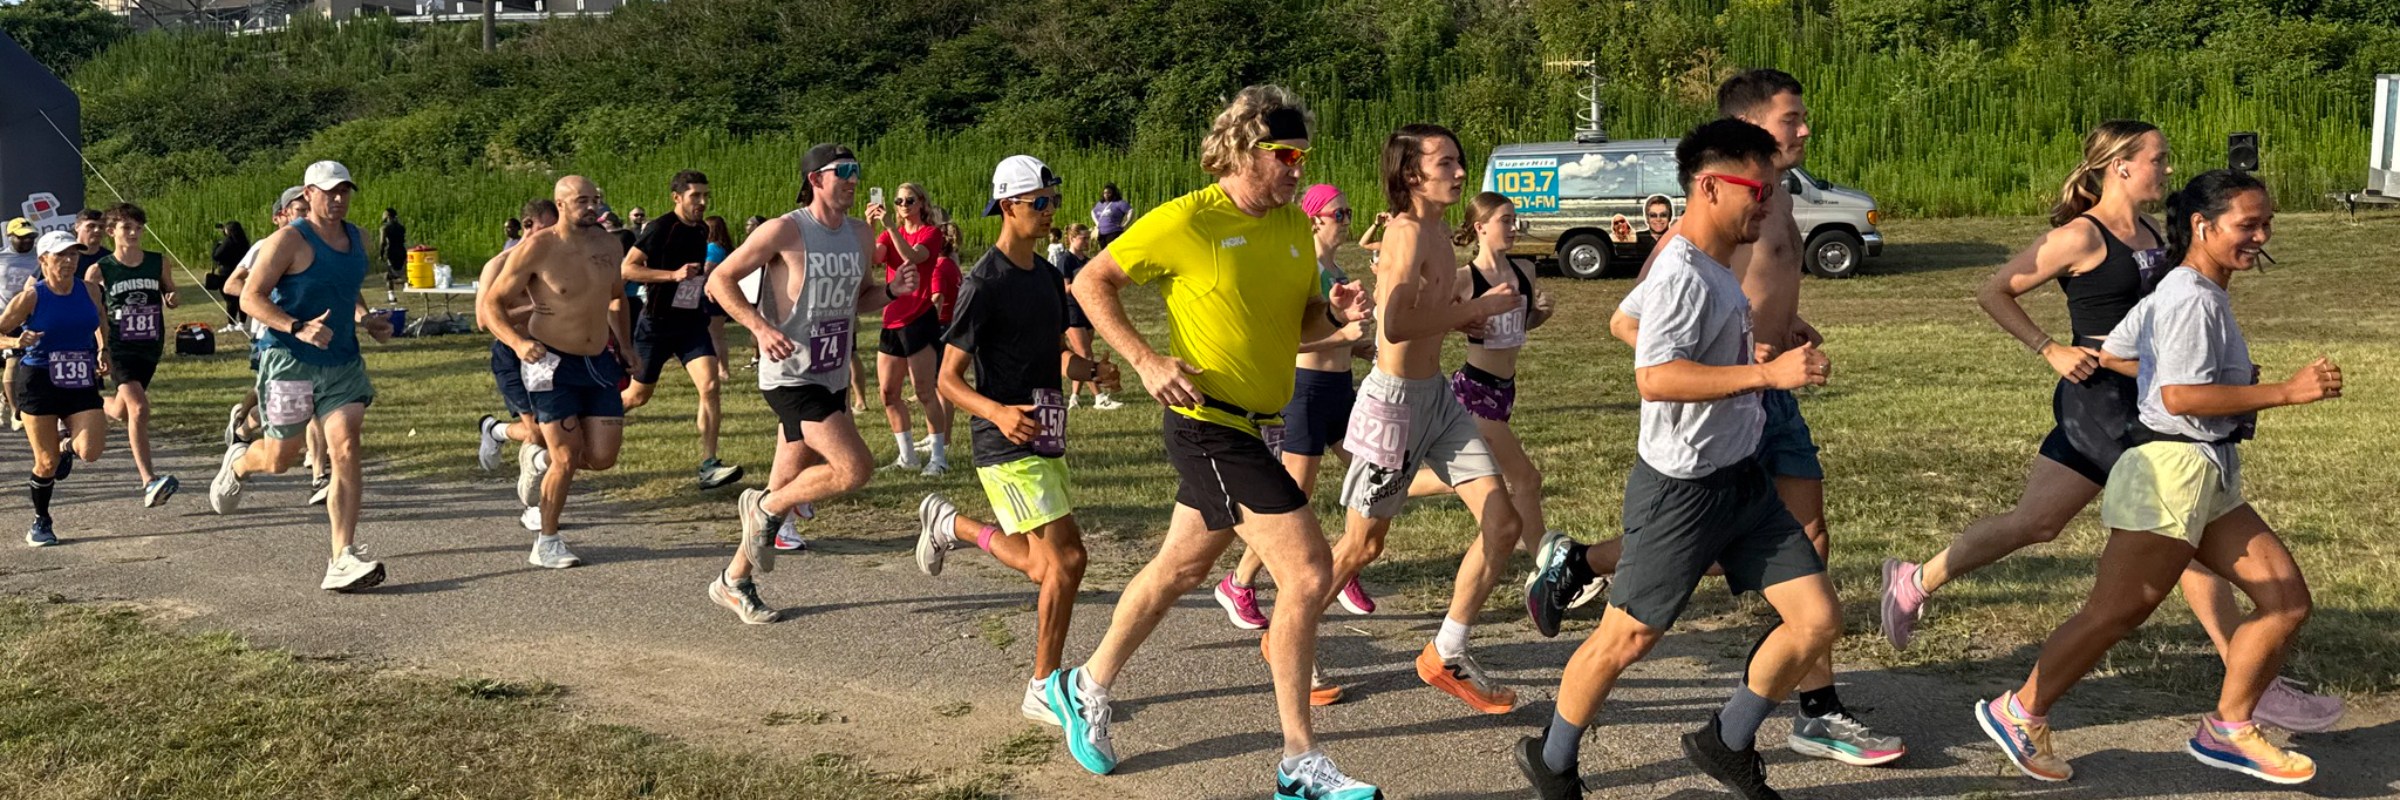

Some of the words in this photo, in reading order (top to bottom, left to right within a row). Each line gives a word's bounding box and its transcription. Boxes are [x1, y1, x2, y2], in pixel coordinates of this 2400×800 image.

[1496, 171, 1555, 193] 103.7
[808, 252, 862, 278] ROCK
[110, 278, 159, 297] JENISON
[126, 315, 155, 331] 181
[820, 335, 838, 361] 74
[54, 361, 88, 379] 139
[270, 394, 309, 413] 314
[1039, 408, 1065, 437] 158
[1352, 411, 1400, 451] 320
